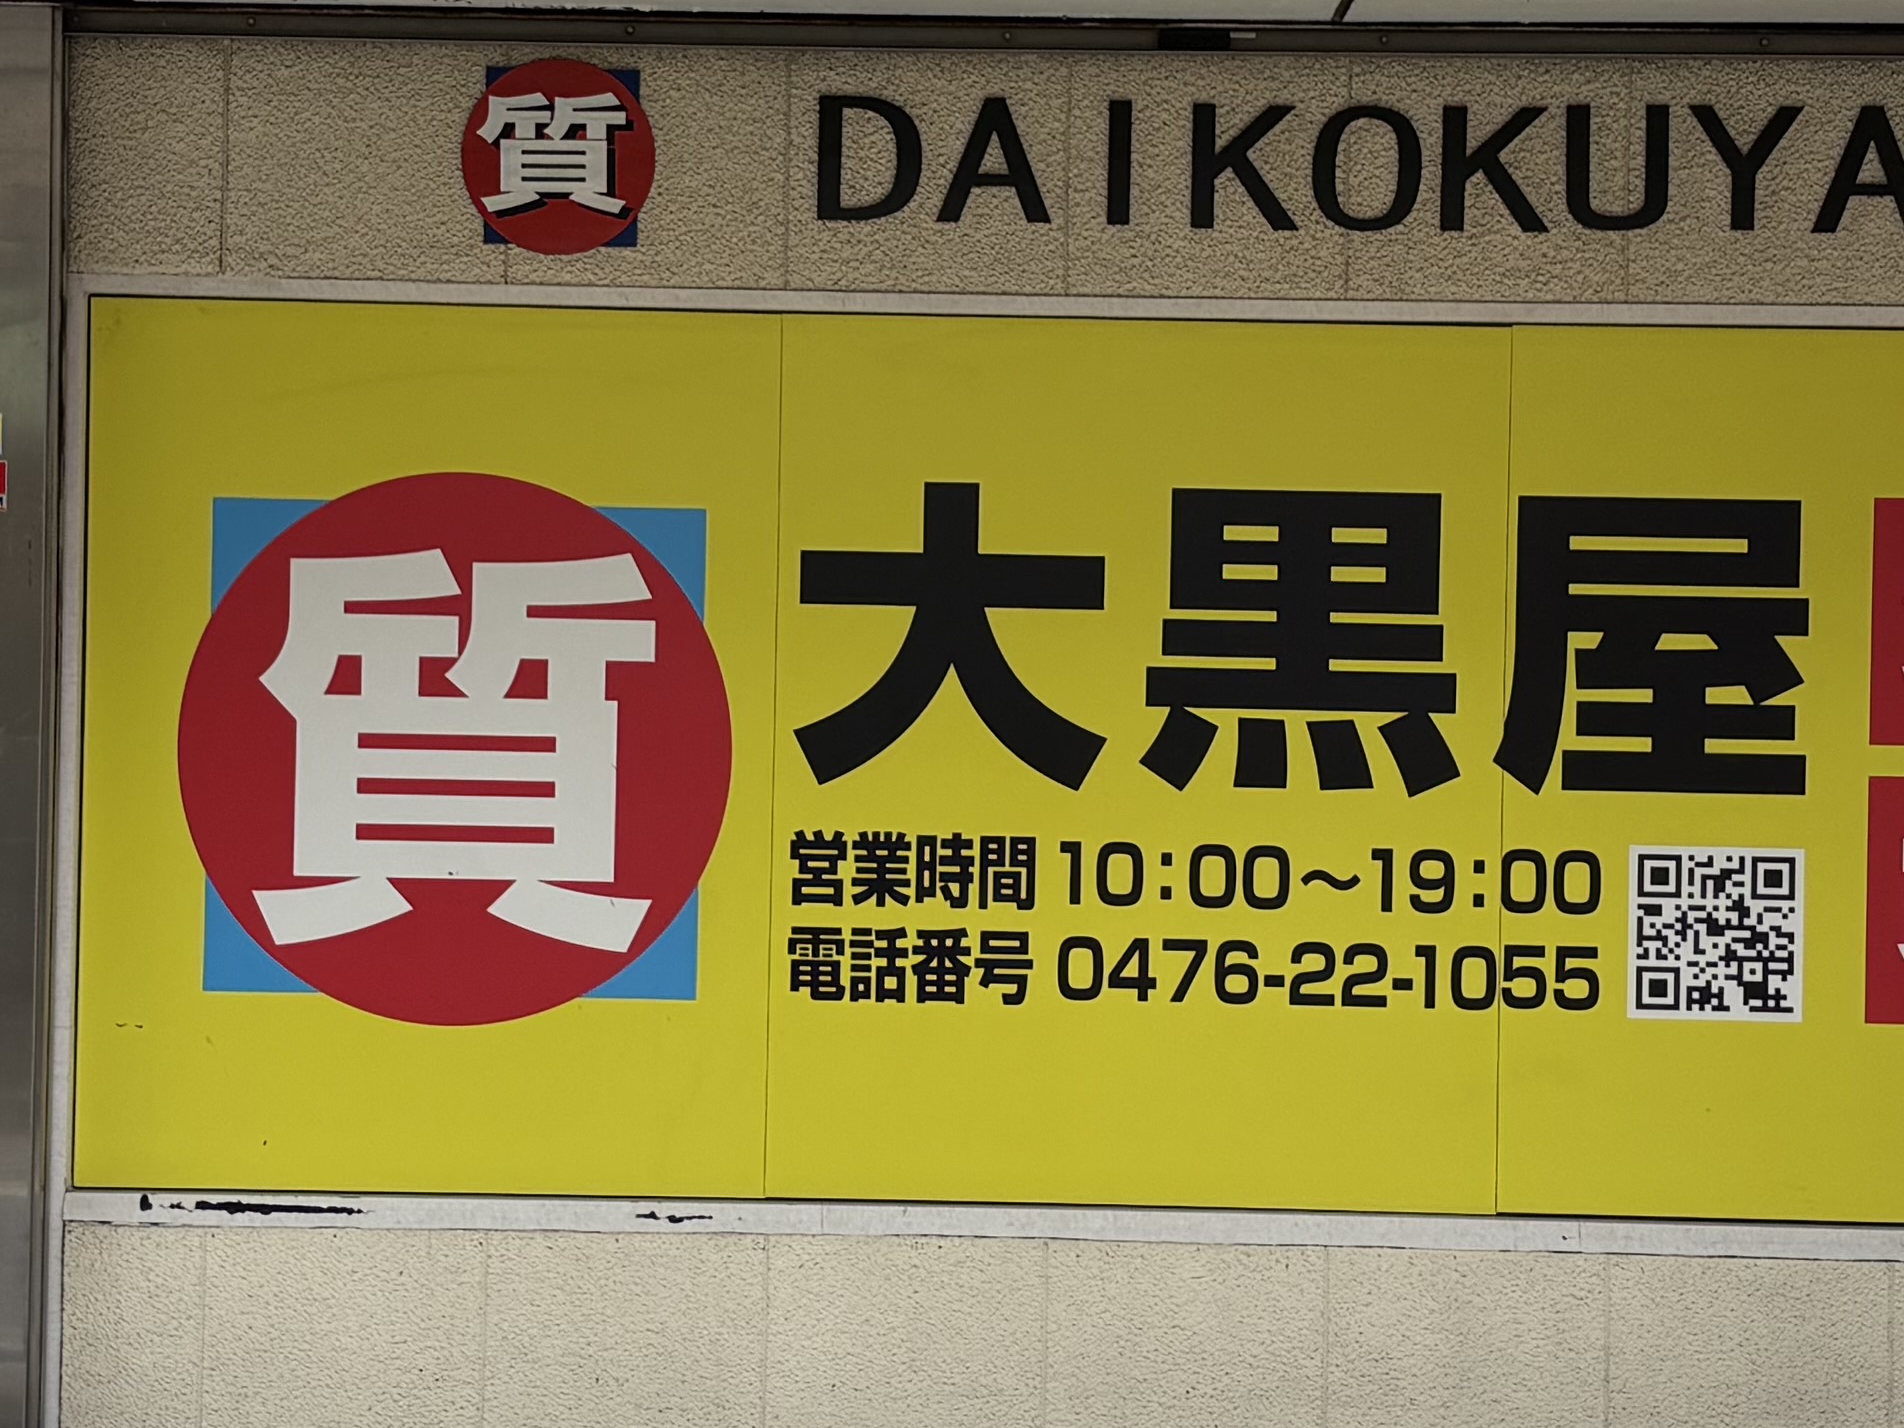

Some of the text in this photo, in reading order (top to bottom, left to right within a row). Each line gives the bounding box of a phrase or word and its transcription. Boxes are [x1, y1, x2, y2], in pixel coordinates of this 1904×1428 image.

[477, 92, 631, 216] 質
[793, 482, 1810, 794] 大黒屋
[251, 549, 656, 952] 質
[789, 831, 1034, 910] 営業時間
[789, 925, 1598, 1011] 電話番号 0476-22-1055
